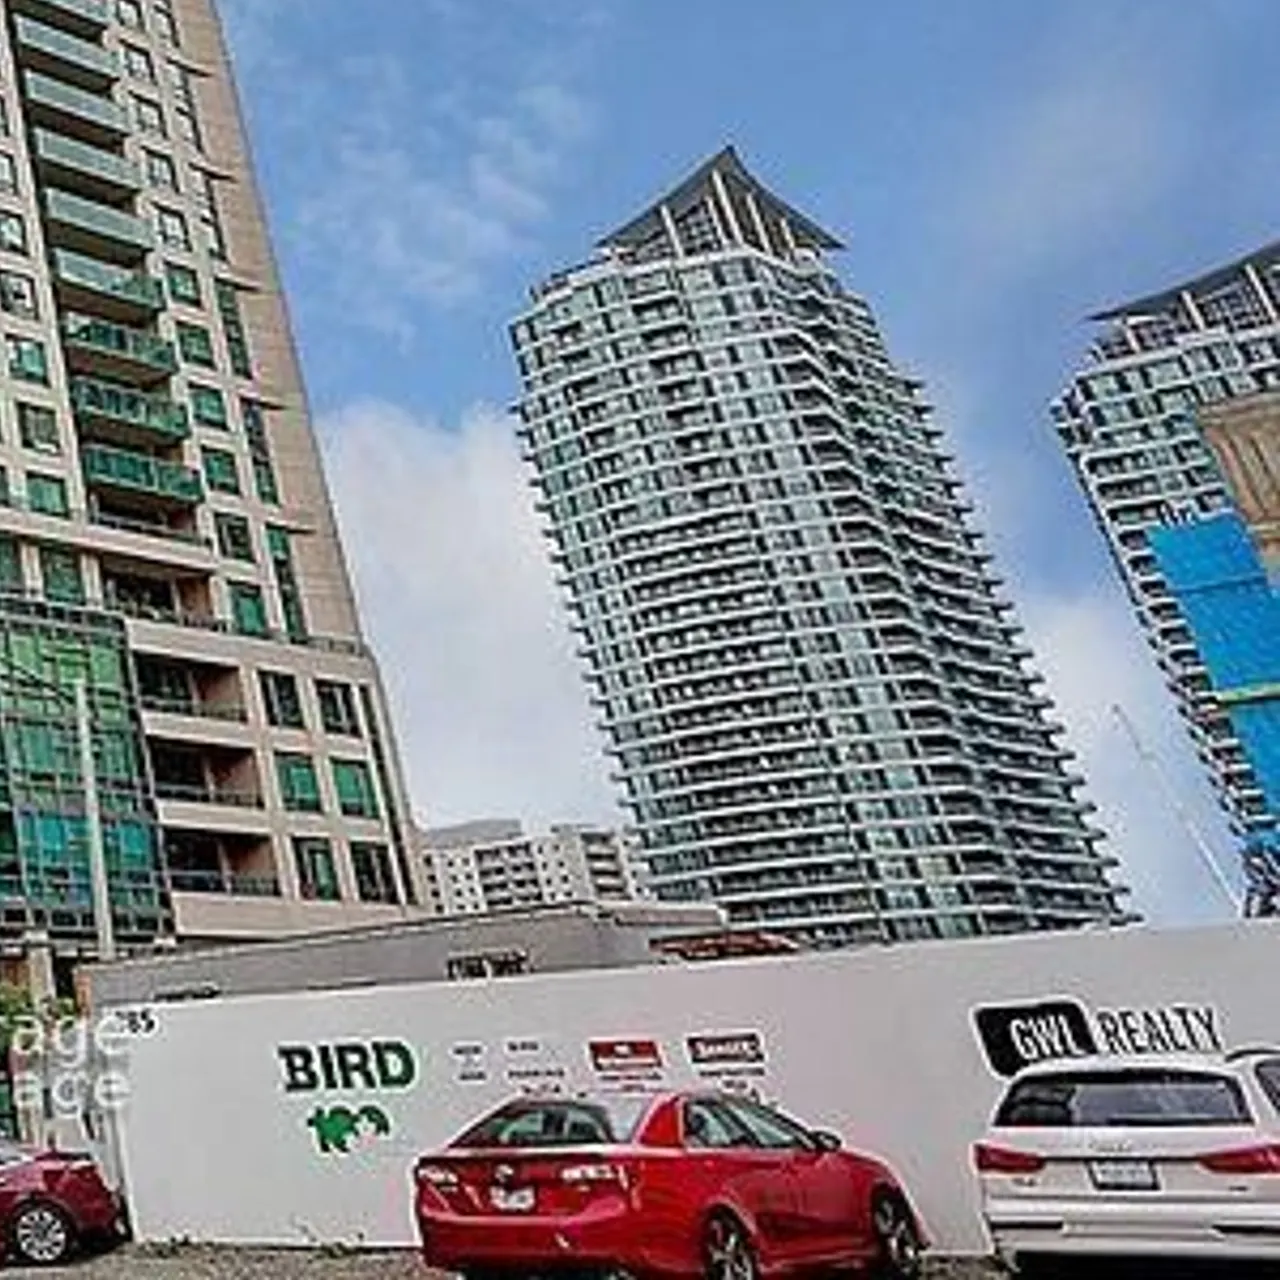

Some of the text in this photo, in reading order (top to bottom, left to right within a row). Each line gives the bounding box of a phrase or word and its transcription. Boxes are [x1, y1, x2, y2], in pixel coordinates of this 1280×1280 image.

[1011, 1005, 1223, 1060] GWL REALTY
[278, 1041, 415, 1093] BIRD
